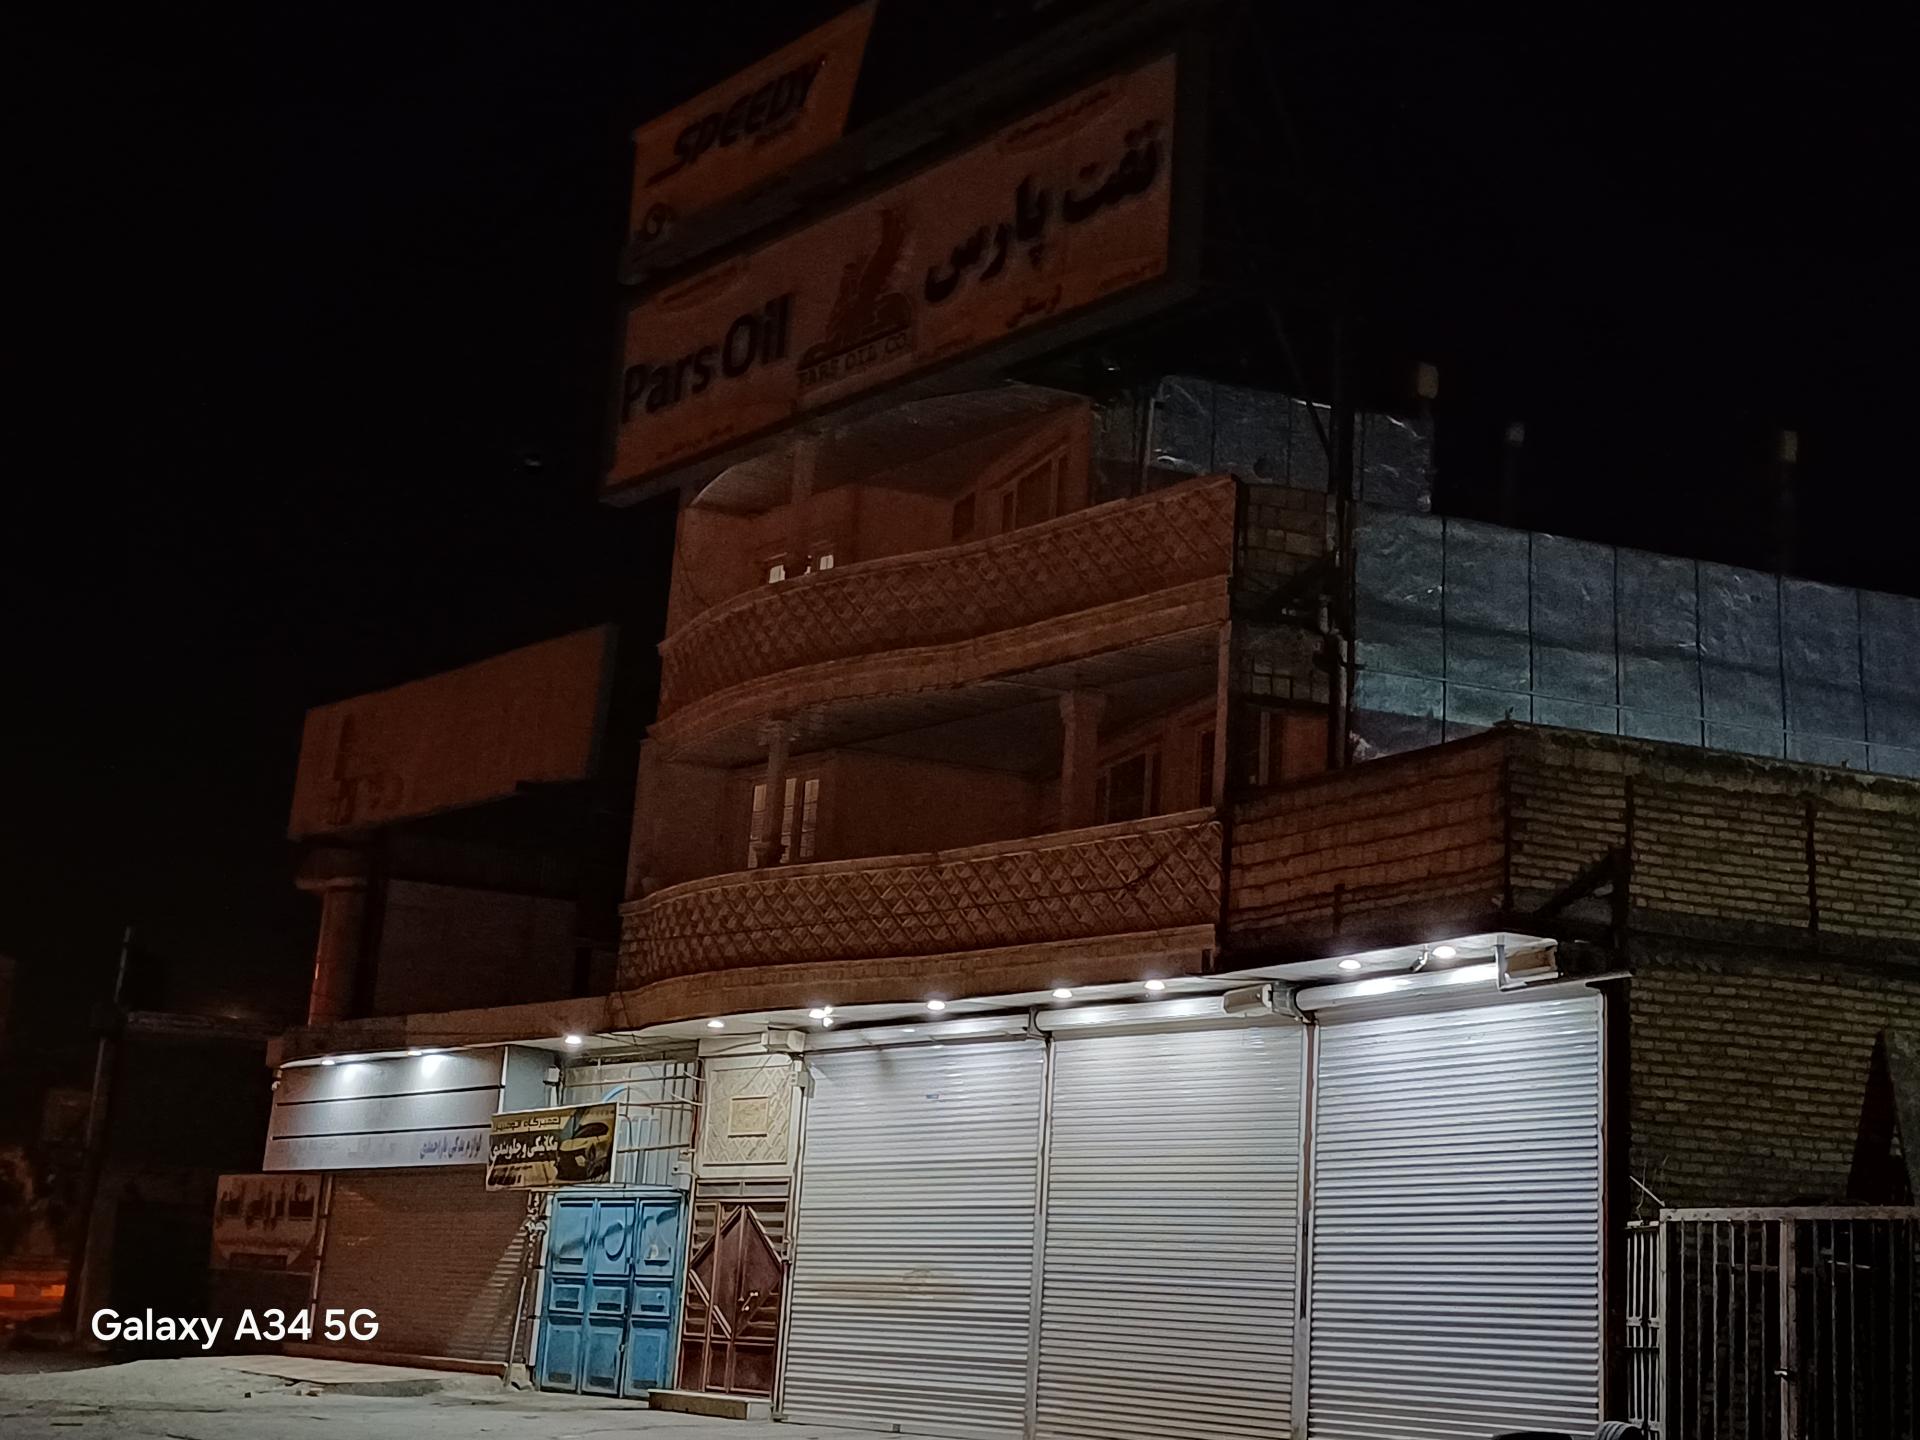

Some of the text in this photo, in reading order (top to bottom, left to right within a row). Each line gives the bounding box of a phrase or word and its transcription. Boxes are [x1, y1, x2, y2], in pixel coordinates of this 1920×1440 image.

[650, 53, 828, 184] SPEEDY
[925, 120, 1164, 304] نفت پارس
[622, 292, 793, 425] Pars Oil
[523, 1116, 561, 1131] تعمیرگاه
[448, 1136, 465, 1159] یدکی
[466, 1133, 483, 1158] لوازم
[489, 1138, 521, 1163] جلوبندی
[527, 1134, 559, 1158] مکانیکی
